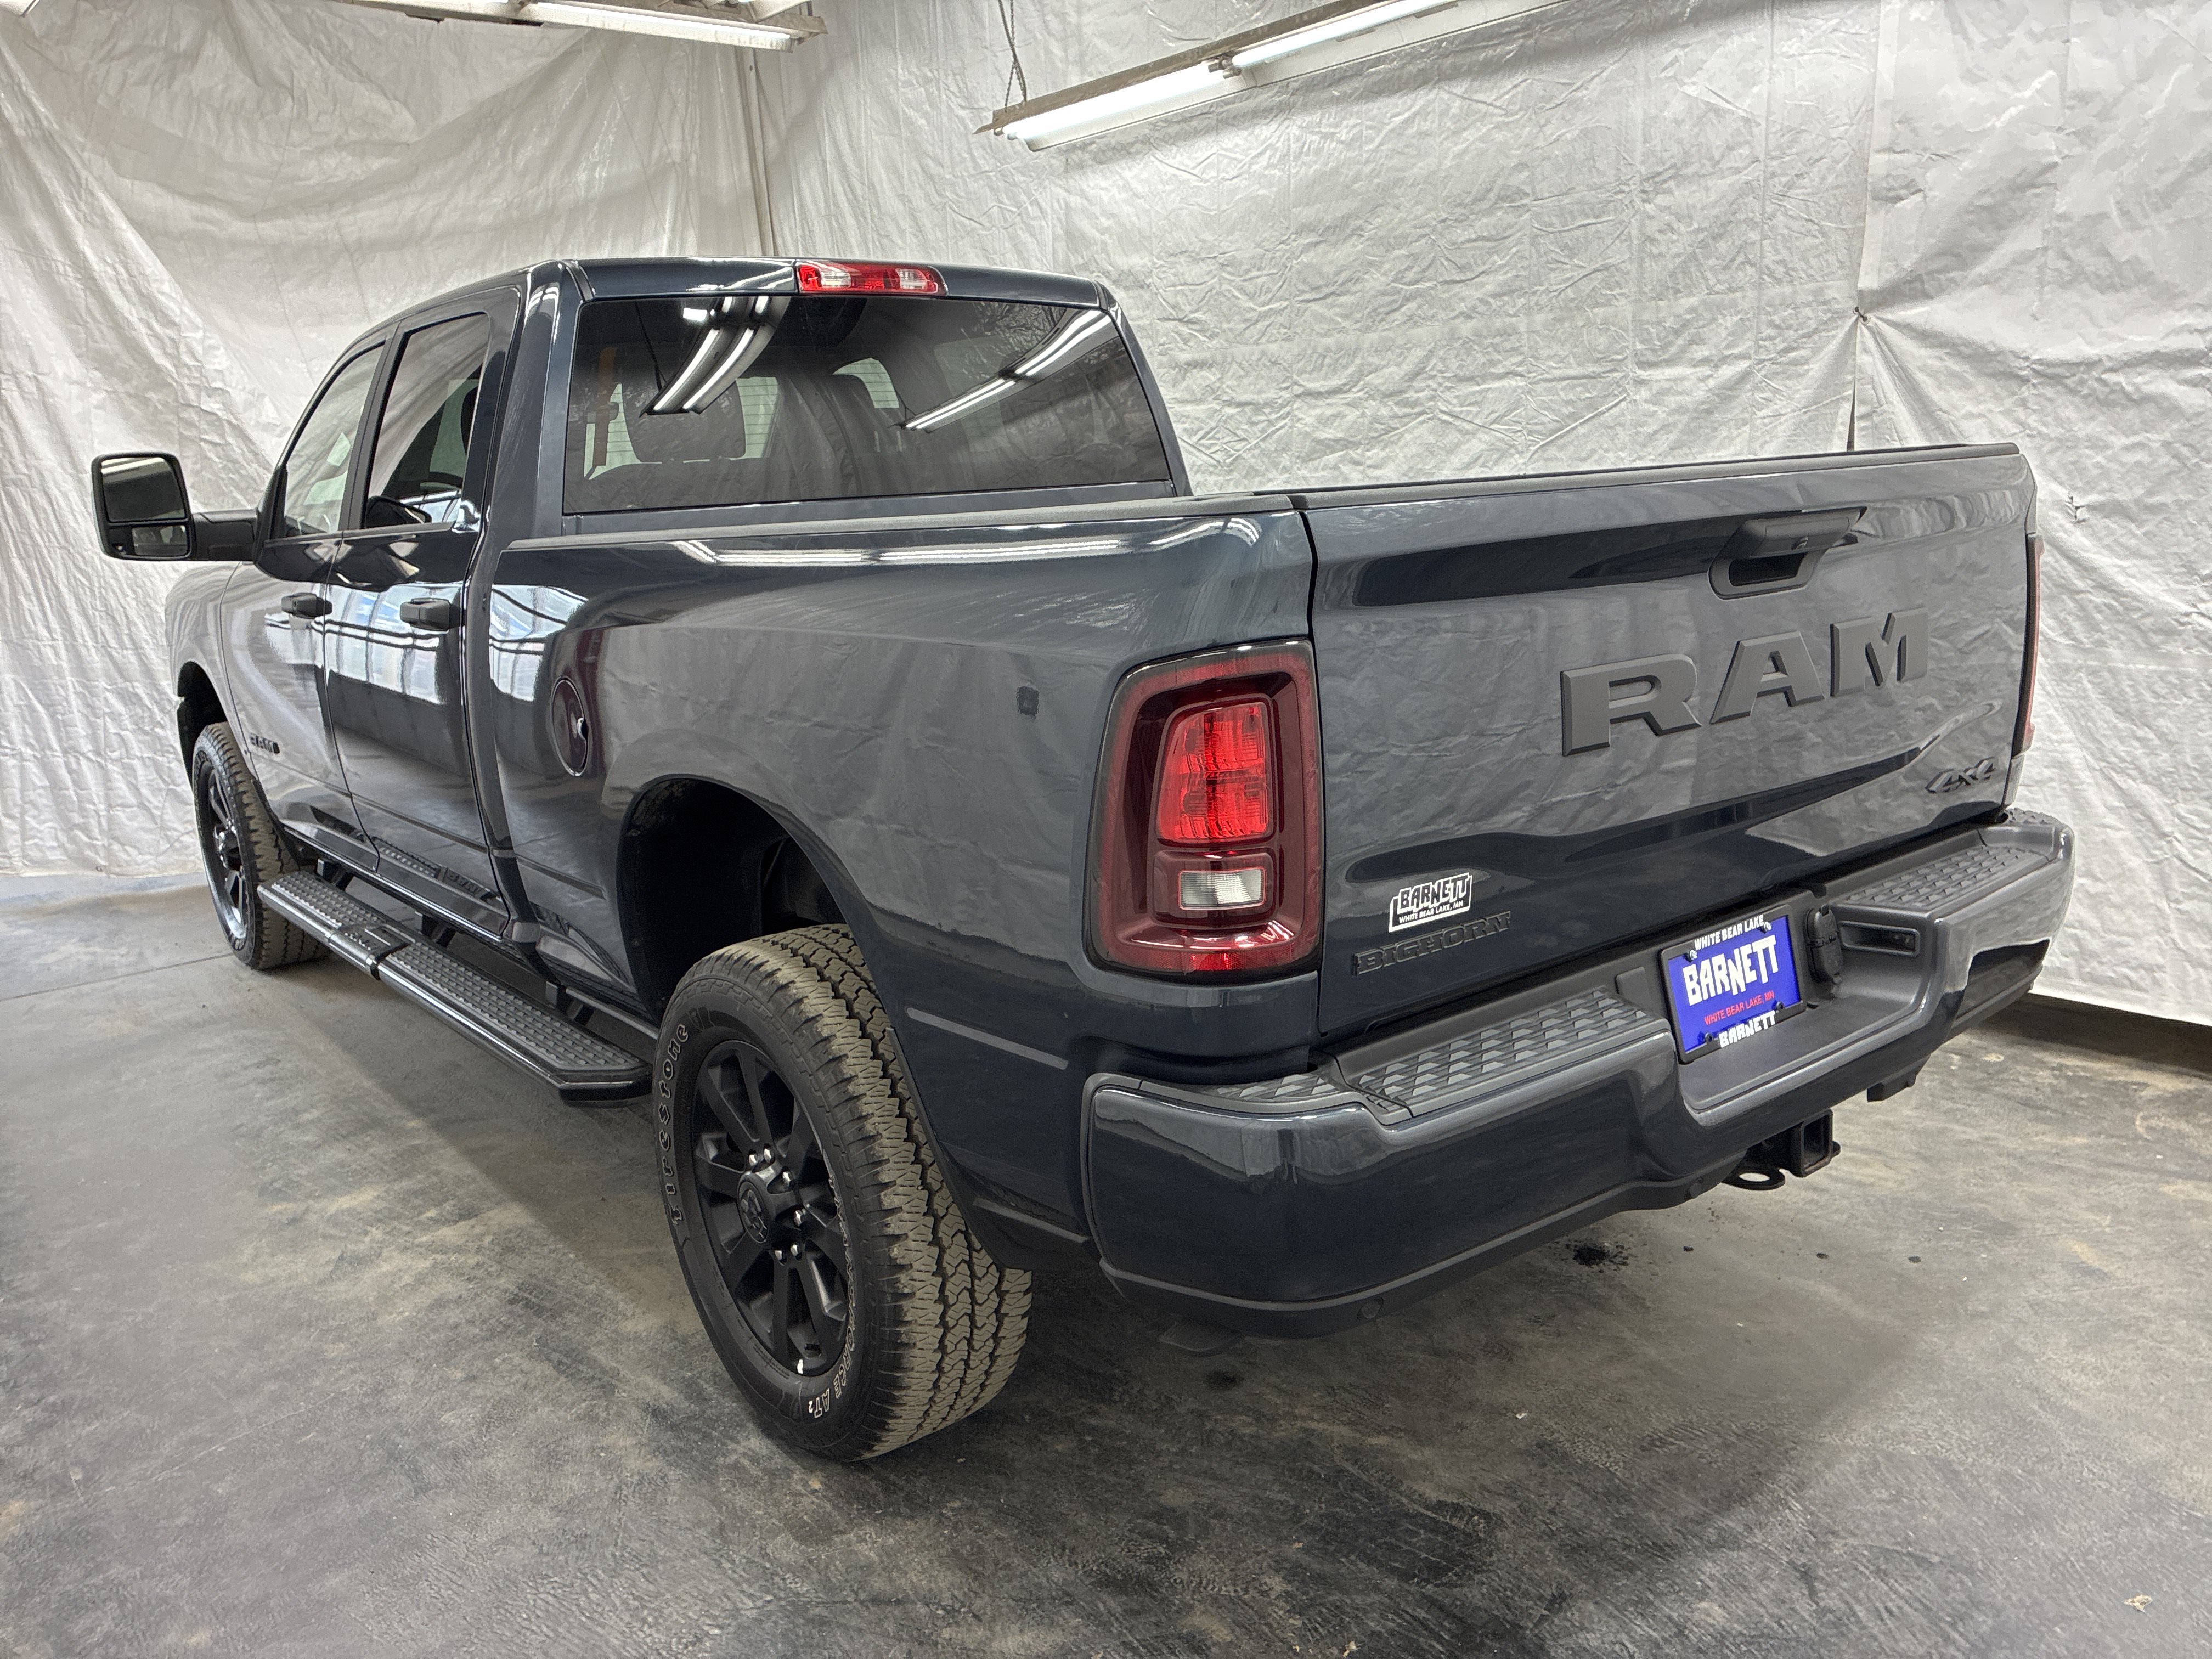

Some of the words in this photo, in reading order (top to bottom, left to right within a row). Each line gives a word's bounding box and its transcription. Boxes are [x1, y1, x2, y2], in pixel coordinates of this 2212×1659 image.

[1560, 607, 1928, 757] RAM
[1398, 873, 1469, 911] BARNETT
[1399, 912, 1418, 924] WHITE
[1419, 908, 1434, 919] BEAR
[1436, 904, 1452, 913] LAKE,
[1453, 900, 1464, 909] MN
[1353, 911, 1510, 975] BIGHORN
[1694, 934, 1720, 951] WHITE
[1722, 923, 1742, 942] BEAR
[1744, 914, 1764, 932] LAKE
[1683, 935, 1779, 1006] BARNETT
[1704, 1009, 1725, 1025] WHITE
[1726, 1001, 1745, 1017] BEAR
[1746, 995, 1764, 1010] LAKE,
[1764, 990, 1775, 1002] MN
[1718, 1010, 1776, 1048] BARNETT
